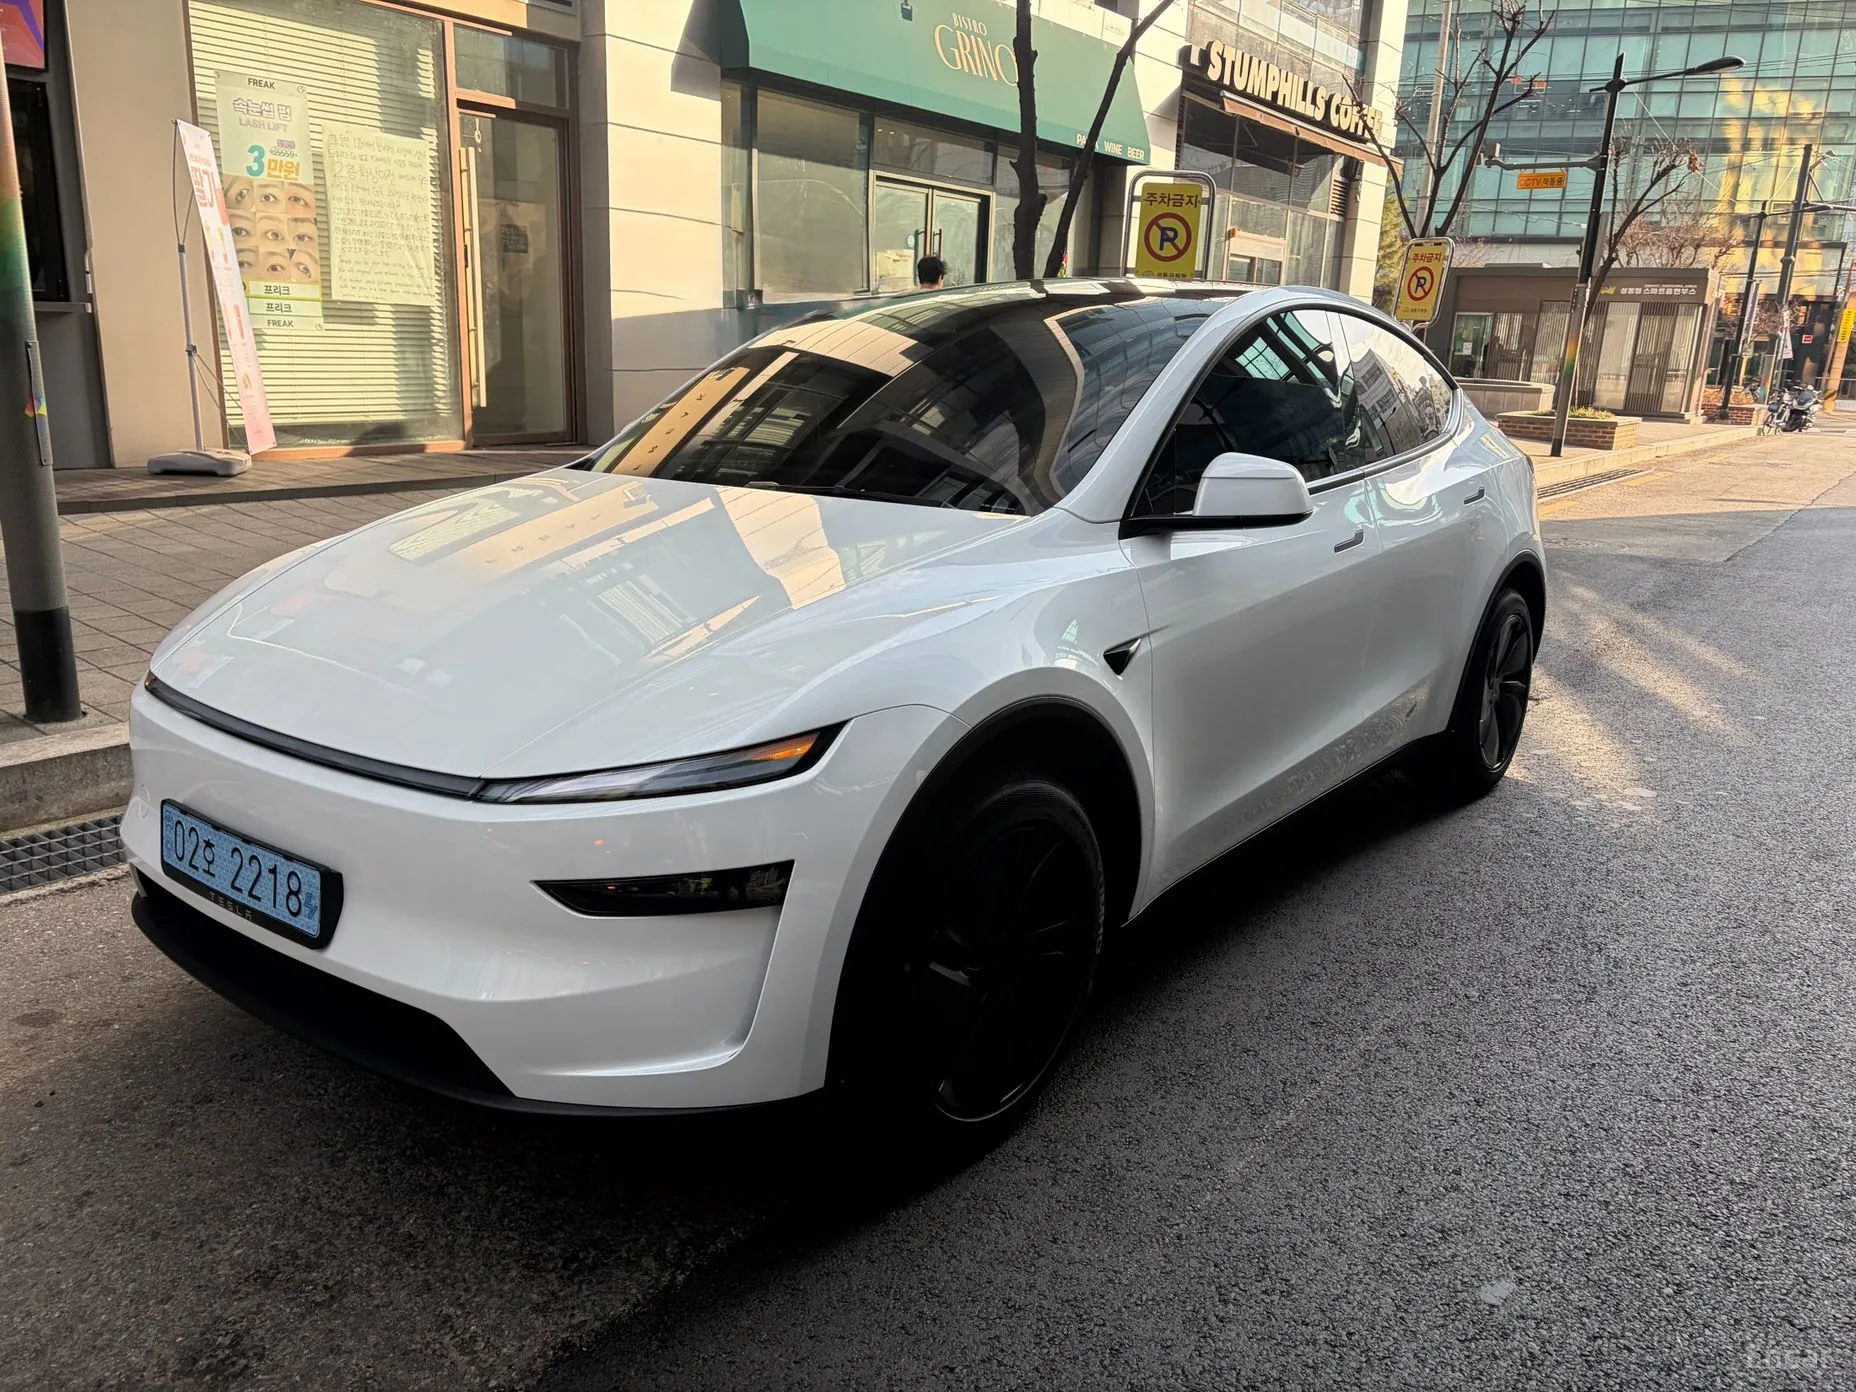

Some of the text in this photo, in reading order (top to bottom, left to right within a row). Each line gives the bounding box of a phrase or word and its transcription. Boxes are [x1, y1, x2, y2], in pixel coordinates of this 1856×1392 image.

[952, 12, 988, 36] BISTRO
[934, 24, 1019, 87] GRINO
[247, 77, 276, 90] FREAK
[1207, 39, 1326, 122] STUMPHILLS
[233, 97, 291, 121] 속눈썹 펌
[239, 117, 289, 132] LASH LIFT
[1104, 140, 1123, 155] WINE
[1127, 147, 1145, 160] BEER
[246, 144, 265, 178] 3
[266, 158, 300, 181] 만원
[1144, 192, 1198, 208] 주차금지
[1412, 252, 1442, 263] 주차금지
[264, 284, 291, 296] 프리크
[265, 302, 292, 313] 프리크
[267, 319, 294, 328] FREAK
[174, 819, 216, 878] 02호
[230, 846, 302, 918] 2218
[209, 890, 252, 921] TESLA
